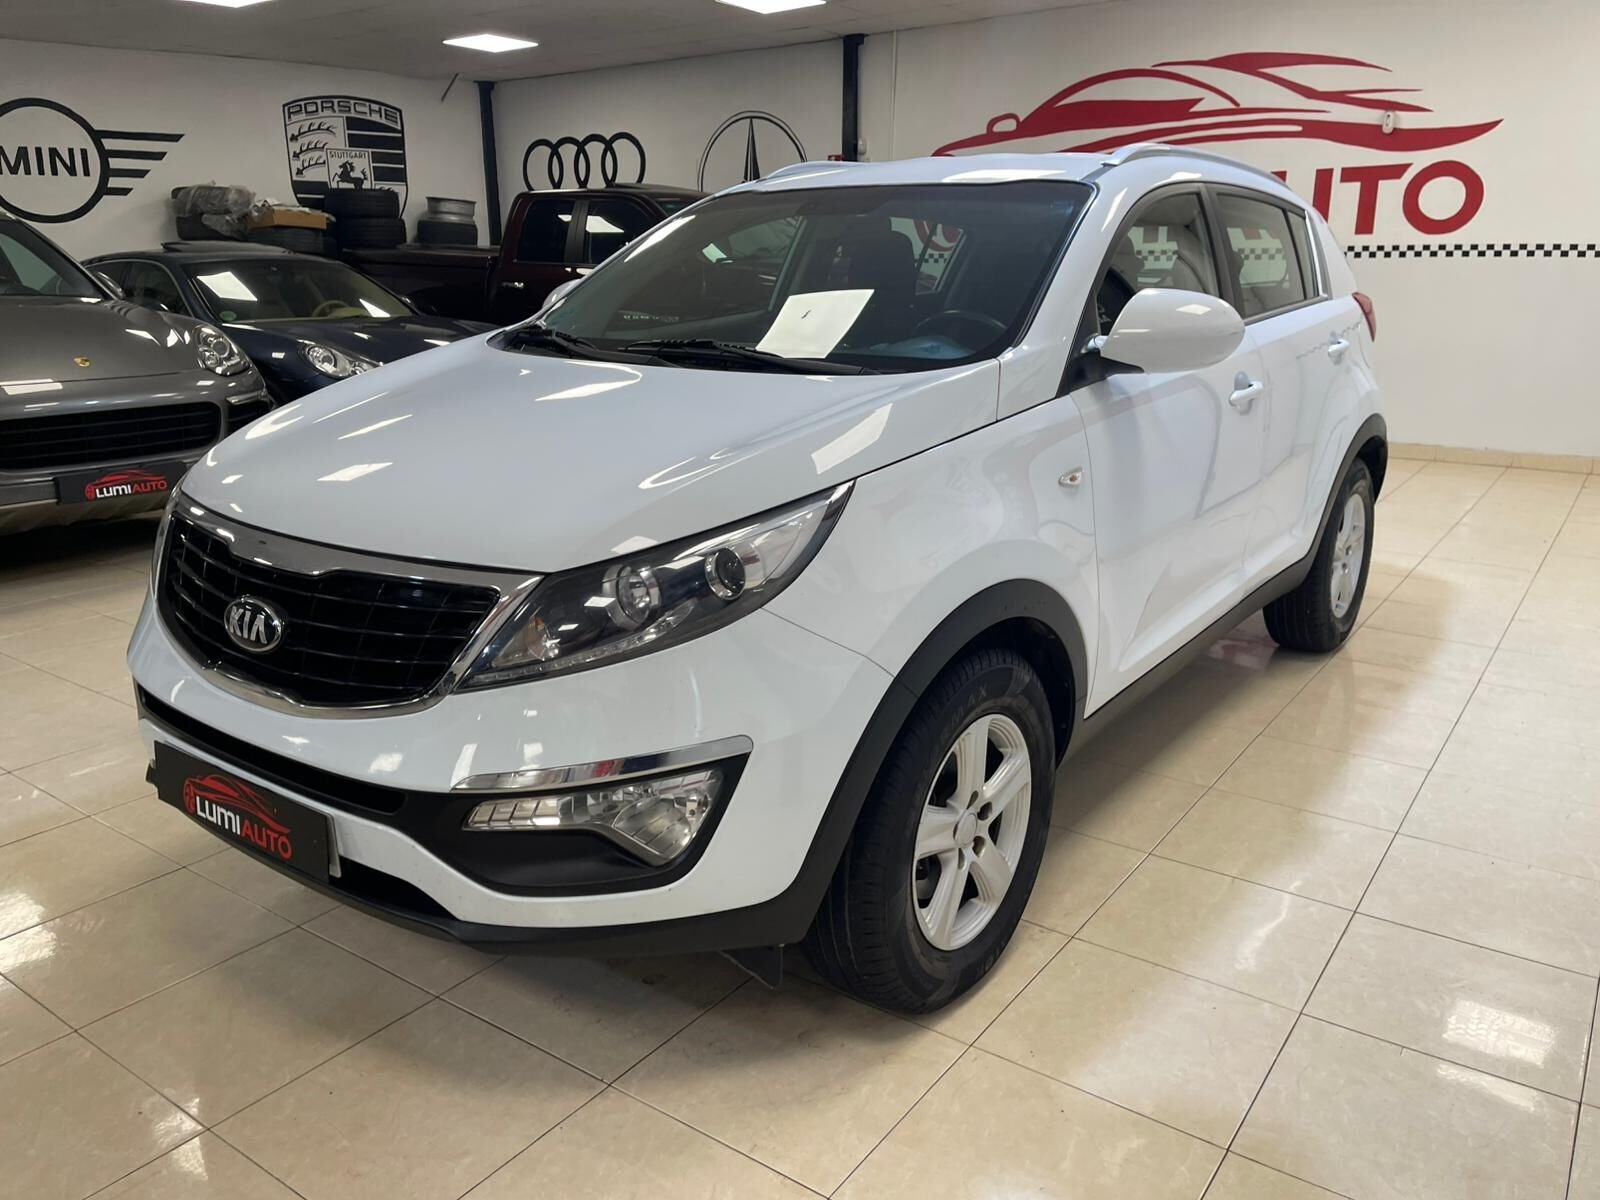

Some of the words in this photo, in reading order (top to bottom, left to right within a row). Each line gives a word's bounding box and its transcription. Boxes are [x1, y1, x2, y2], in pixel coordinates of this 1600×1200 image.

[287, 100, 399, 126] PORSCHE
[0, 146, 90, 176] MINI
[329, 151, 367, 159] STUTTGART
[229, 605, 268, 645] KIA
